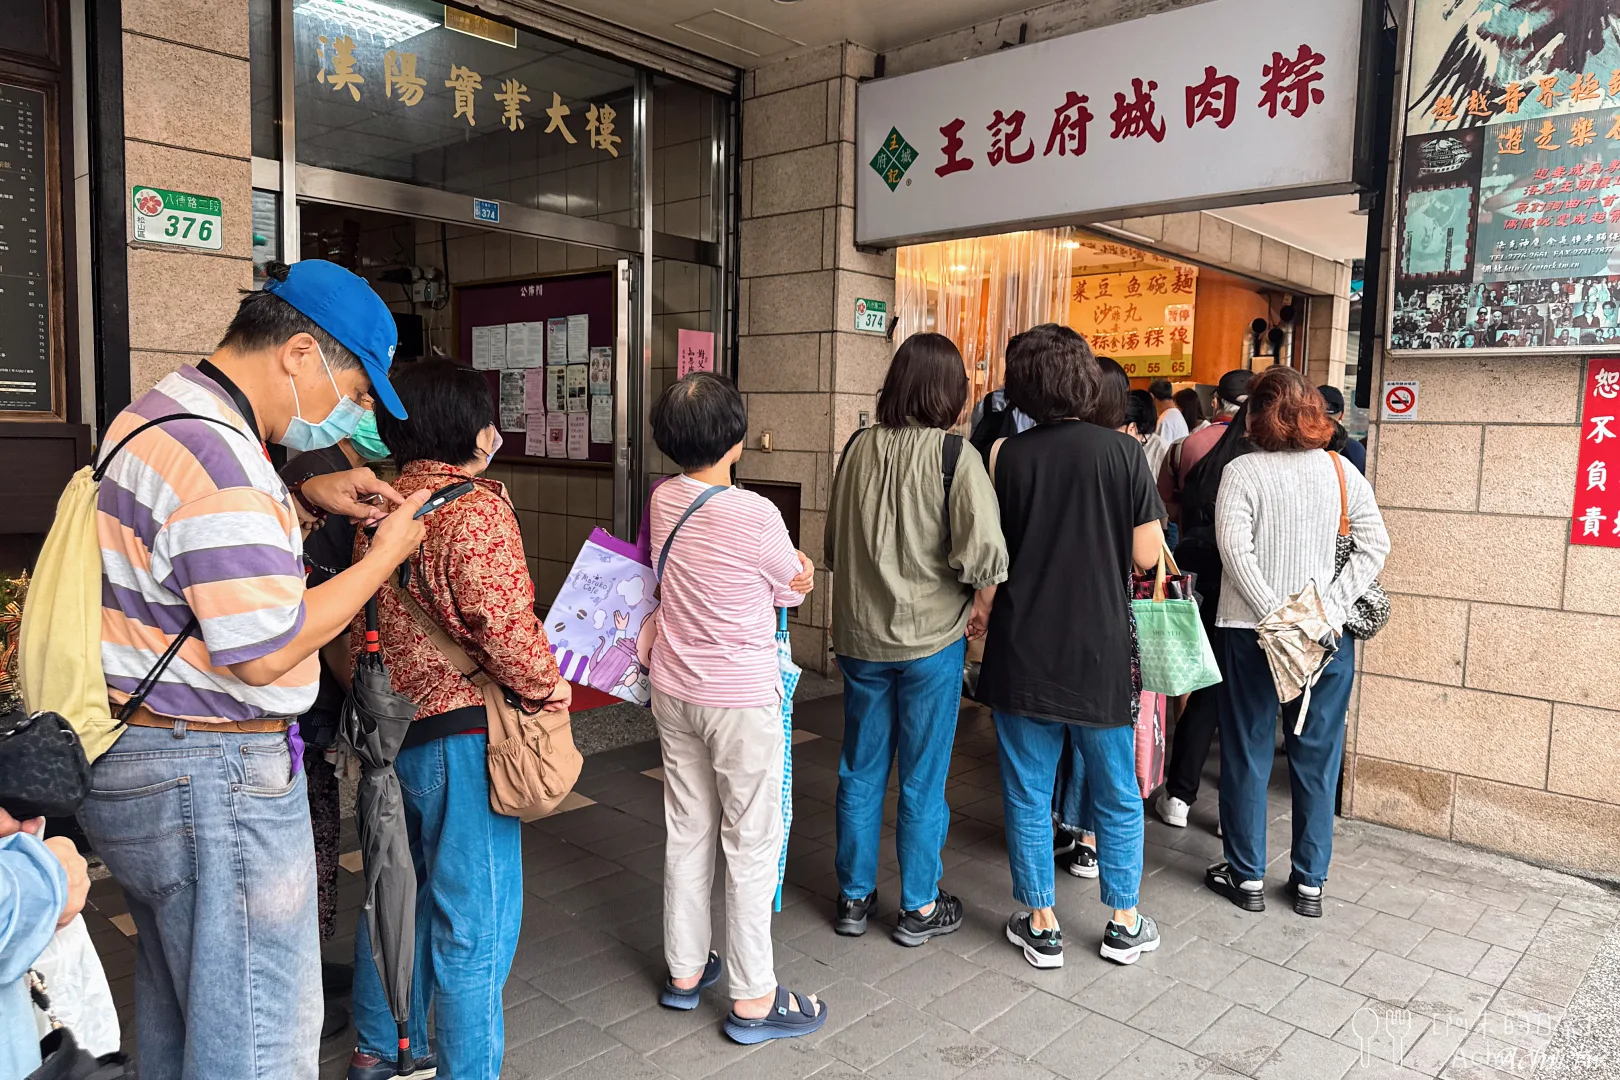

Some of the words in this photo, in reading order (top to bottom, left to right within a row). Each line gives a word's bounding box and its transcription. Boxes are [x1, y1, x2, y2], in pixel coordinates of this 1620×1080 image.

[316, 35, 621, 157] 漢陽實業大樓
[935, 44, 1326, 177] 王記府城肉粽
[889, 133, 900, 151] 王
[877, 152, 888, 169] 府
[900, 148, 912, 164] 城
[887, 168, 901, 183] 記
[165, 194, 220, 212] 八德路二段
[481, 209, 495, 219] 374
[164, 215, 213, 241] 376
[866, 313, 883, 328] 374
[1147, 362, 1160, 373] 55
[1577, 367, 1620, 538] 恕不負責
[581, 573, 607, 590] Maruko
[583, 583, 598, 595] Cafe
